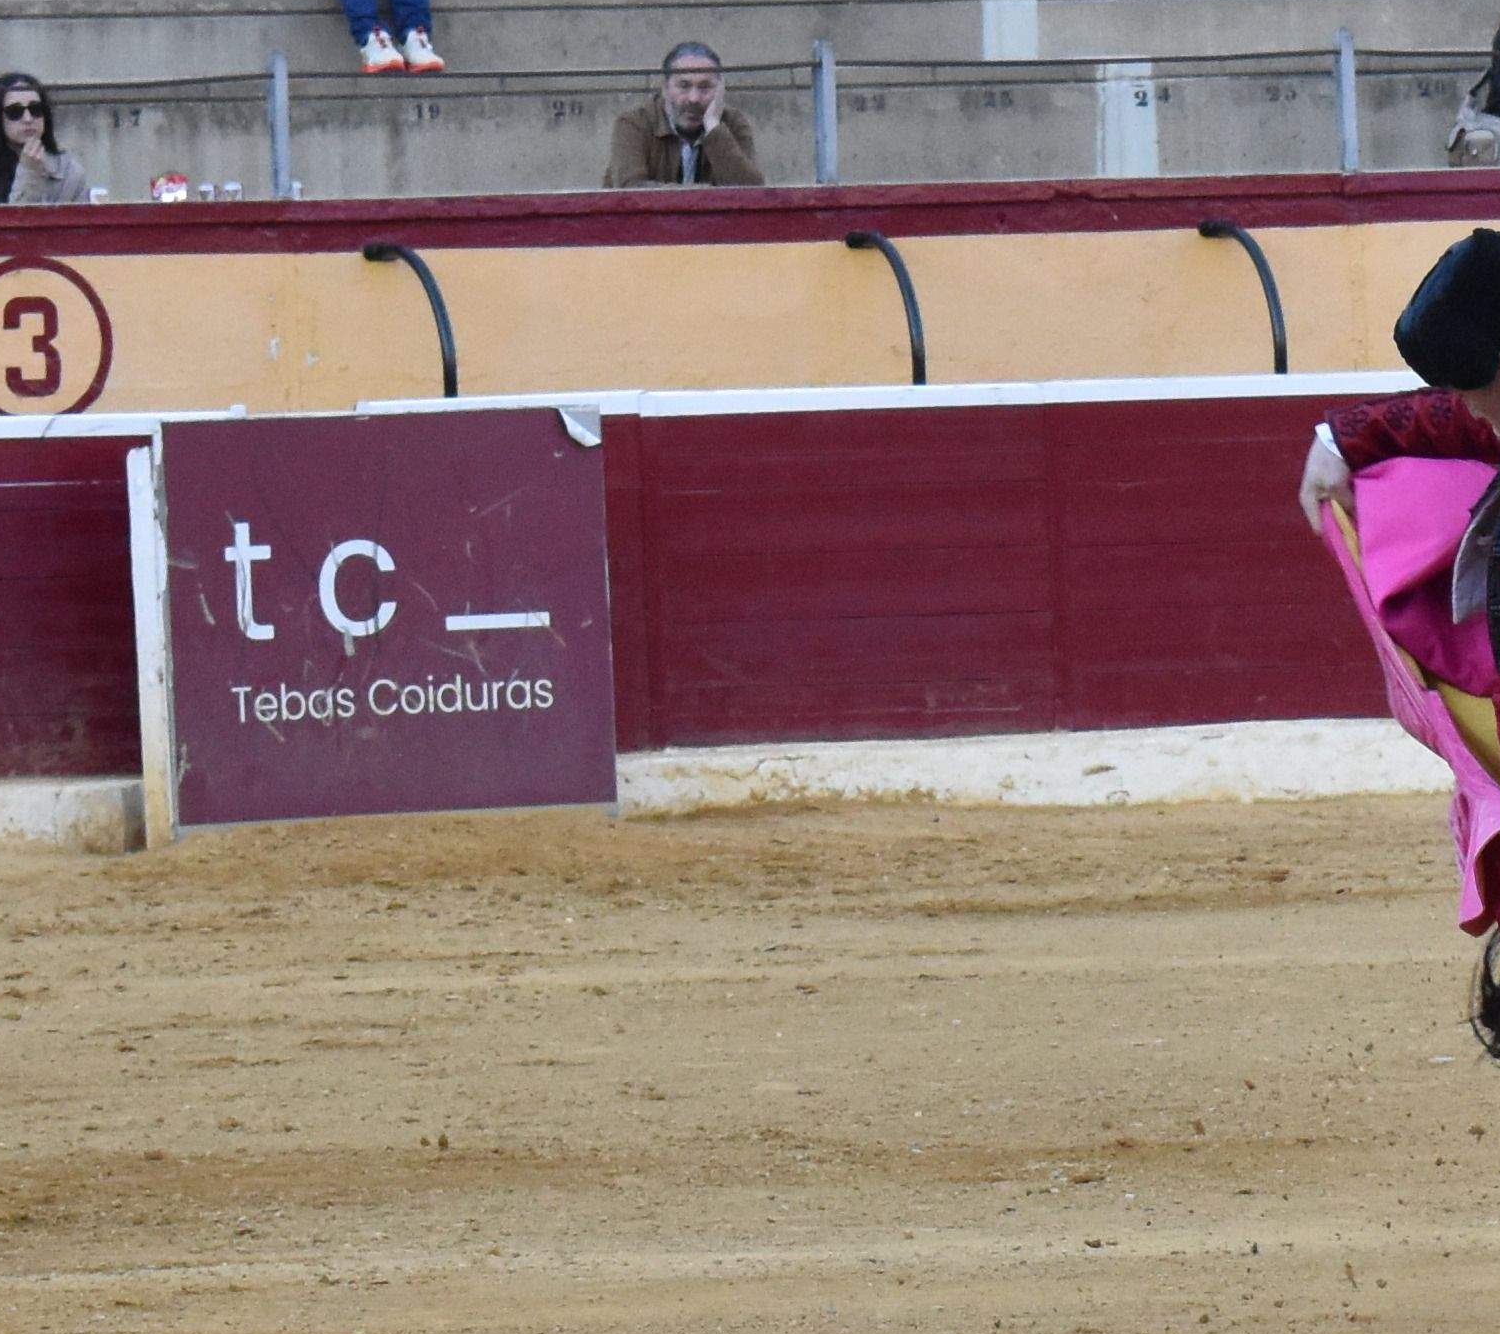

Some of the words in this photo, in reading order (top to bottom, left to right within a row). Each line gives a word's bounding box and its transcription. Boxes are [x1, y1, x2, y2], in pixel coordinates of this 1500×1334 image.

[3, 297, 62, 397] 3
[231, 684, 356, 724] Tebas
[369, 674, 554, 715] Coiduras
